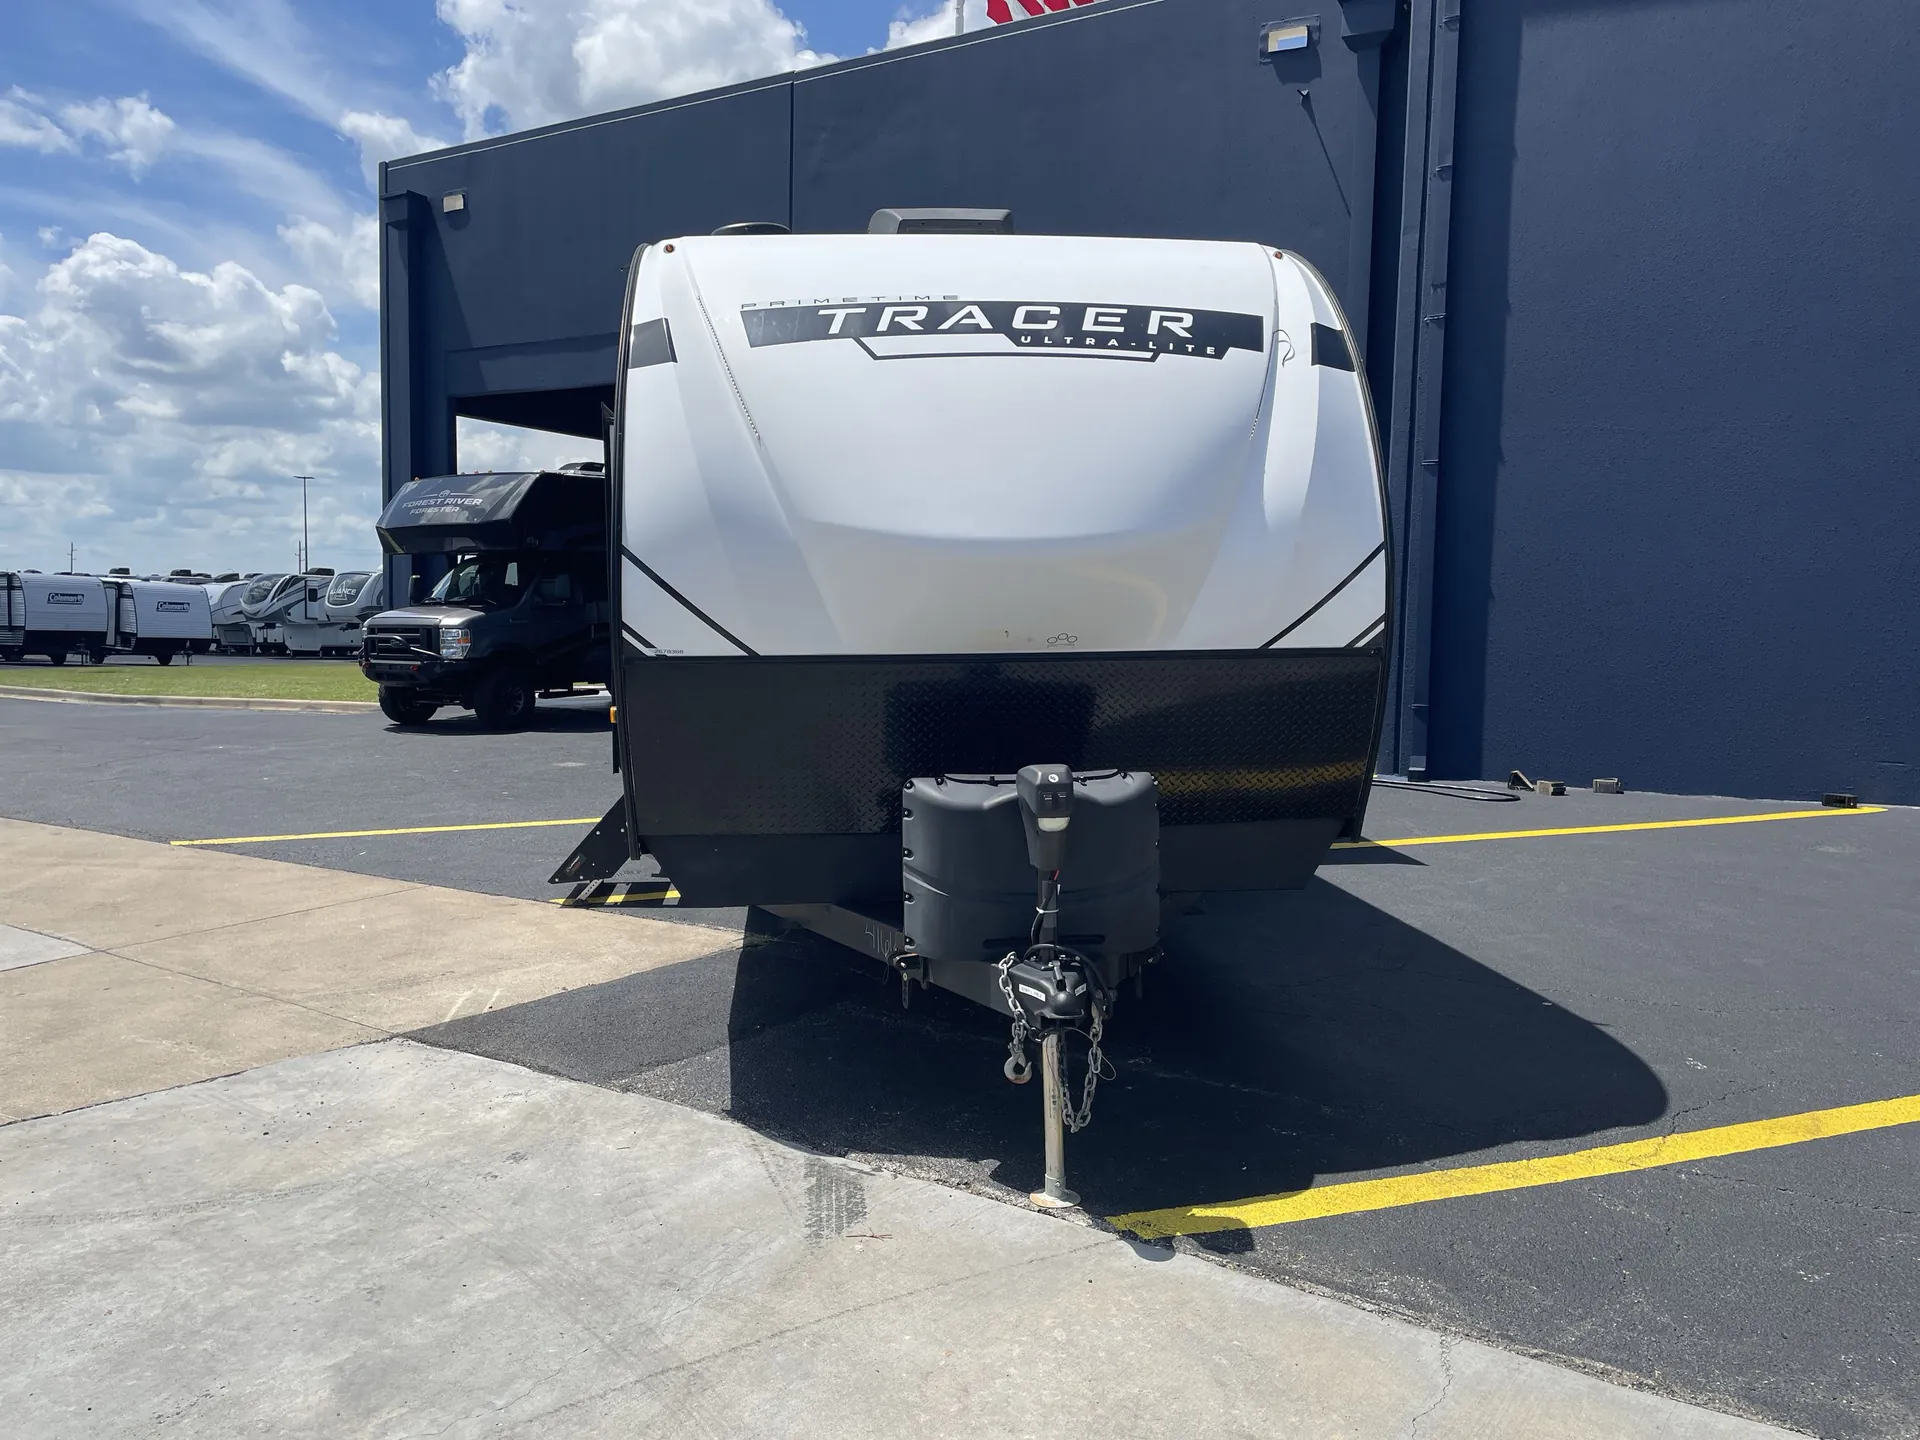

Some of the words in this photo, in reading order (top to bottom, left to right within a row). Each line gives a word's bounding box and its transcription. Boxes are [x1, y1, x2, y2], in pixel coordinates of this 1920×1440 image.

[817, 305, 1194, 339] TRACER
[1020, 335, 1216, 355] ULTRA-LITE
[402, 499, 444, 509] FOREST
[444, 498, 483, 506] RIVER
[409, 506, 460, 515] FORESTER
[49, 593, 77, 602] Coleman
[157, 601, 184, 611] Coleman
